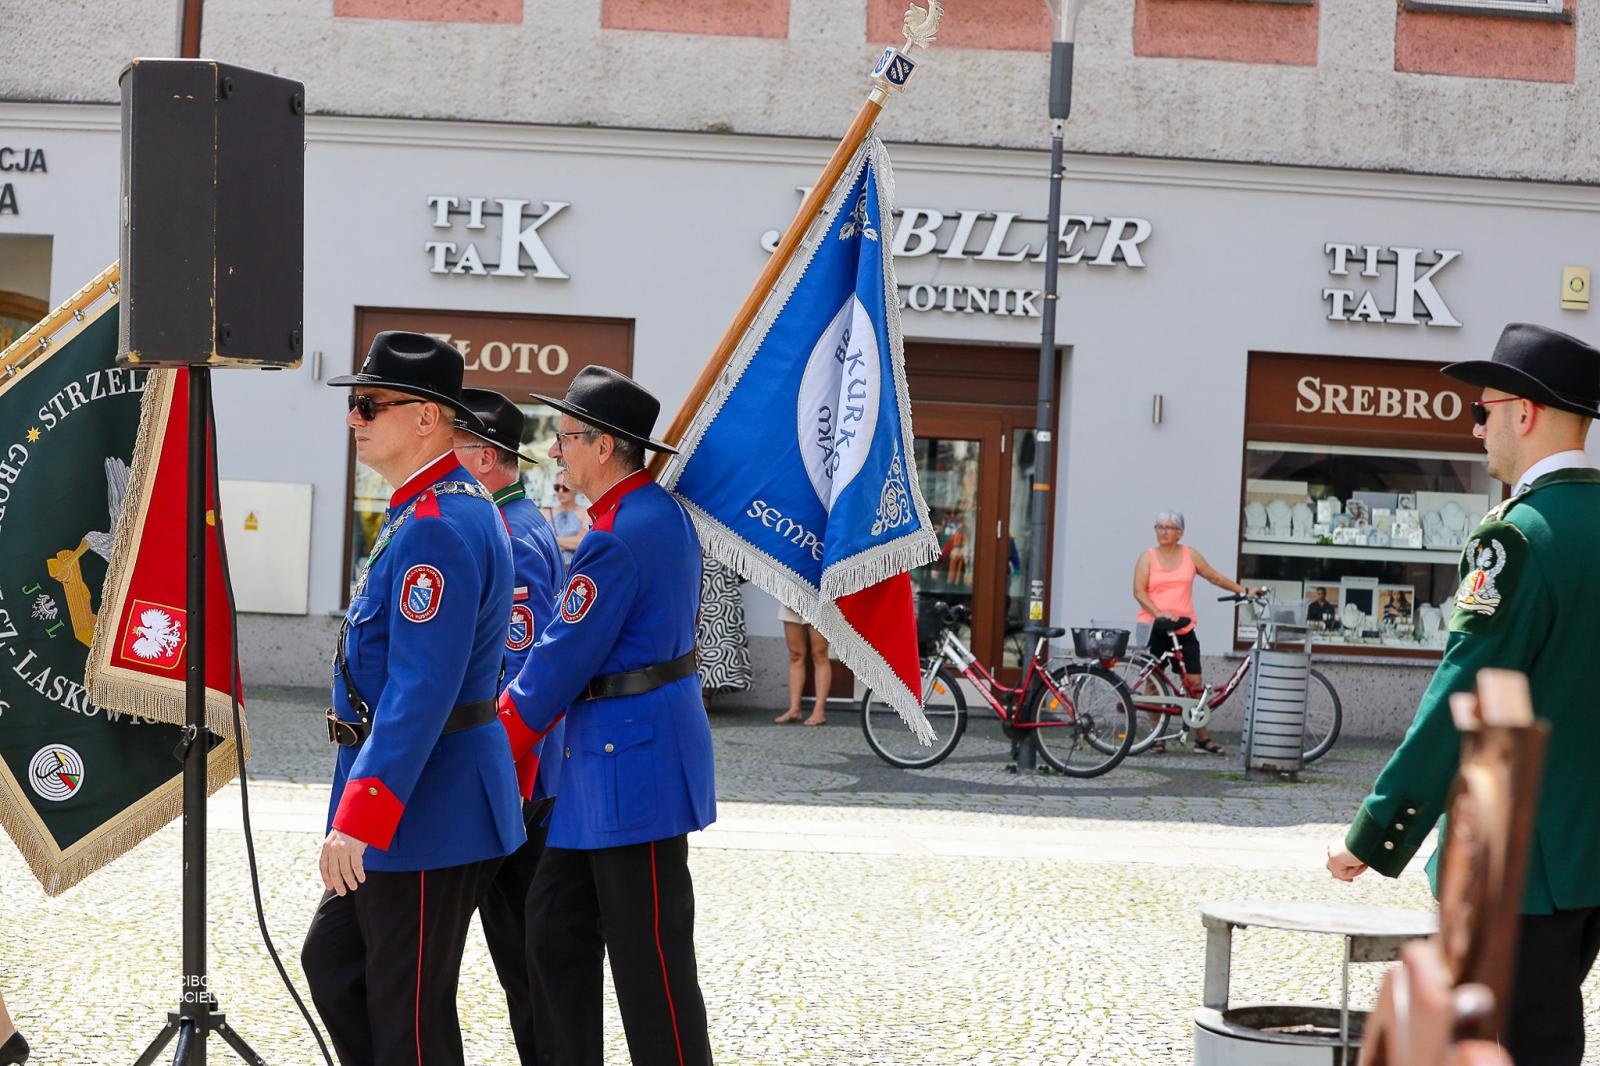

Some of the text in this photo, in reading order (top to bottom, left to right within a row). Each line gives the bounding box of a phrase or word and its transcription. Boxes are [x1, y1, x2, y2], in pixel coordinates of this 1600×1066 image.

[0, 147, 47, 173] CJA
[0, 183, 19, 215] A
[760, 186, 1153, 268] BILER
[898, 283, 1042, 317] OTNIK
[38, 367, 145, 431] STRZEL
[832, 348, 866, 449] KURK
[746, 499, 825, 561] SEMPE
